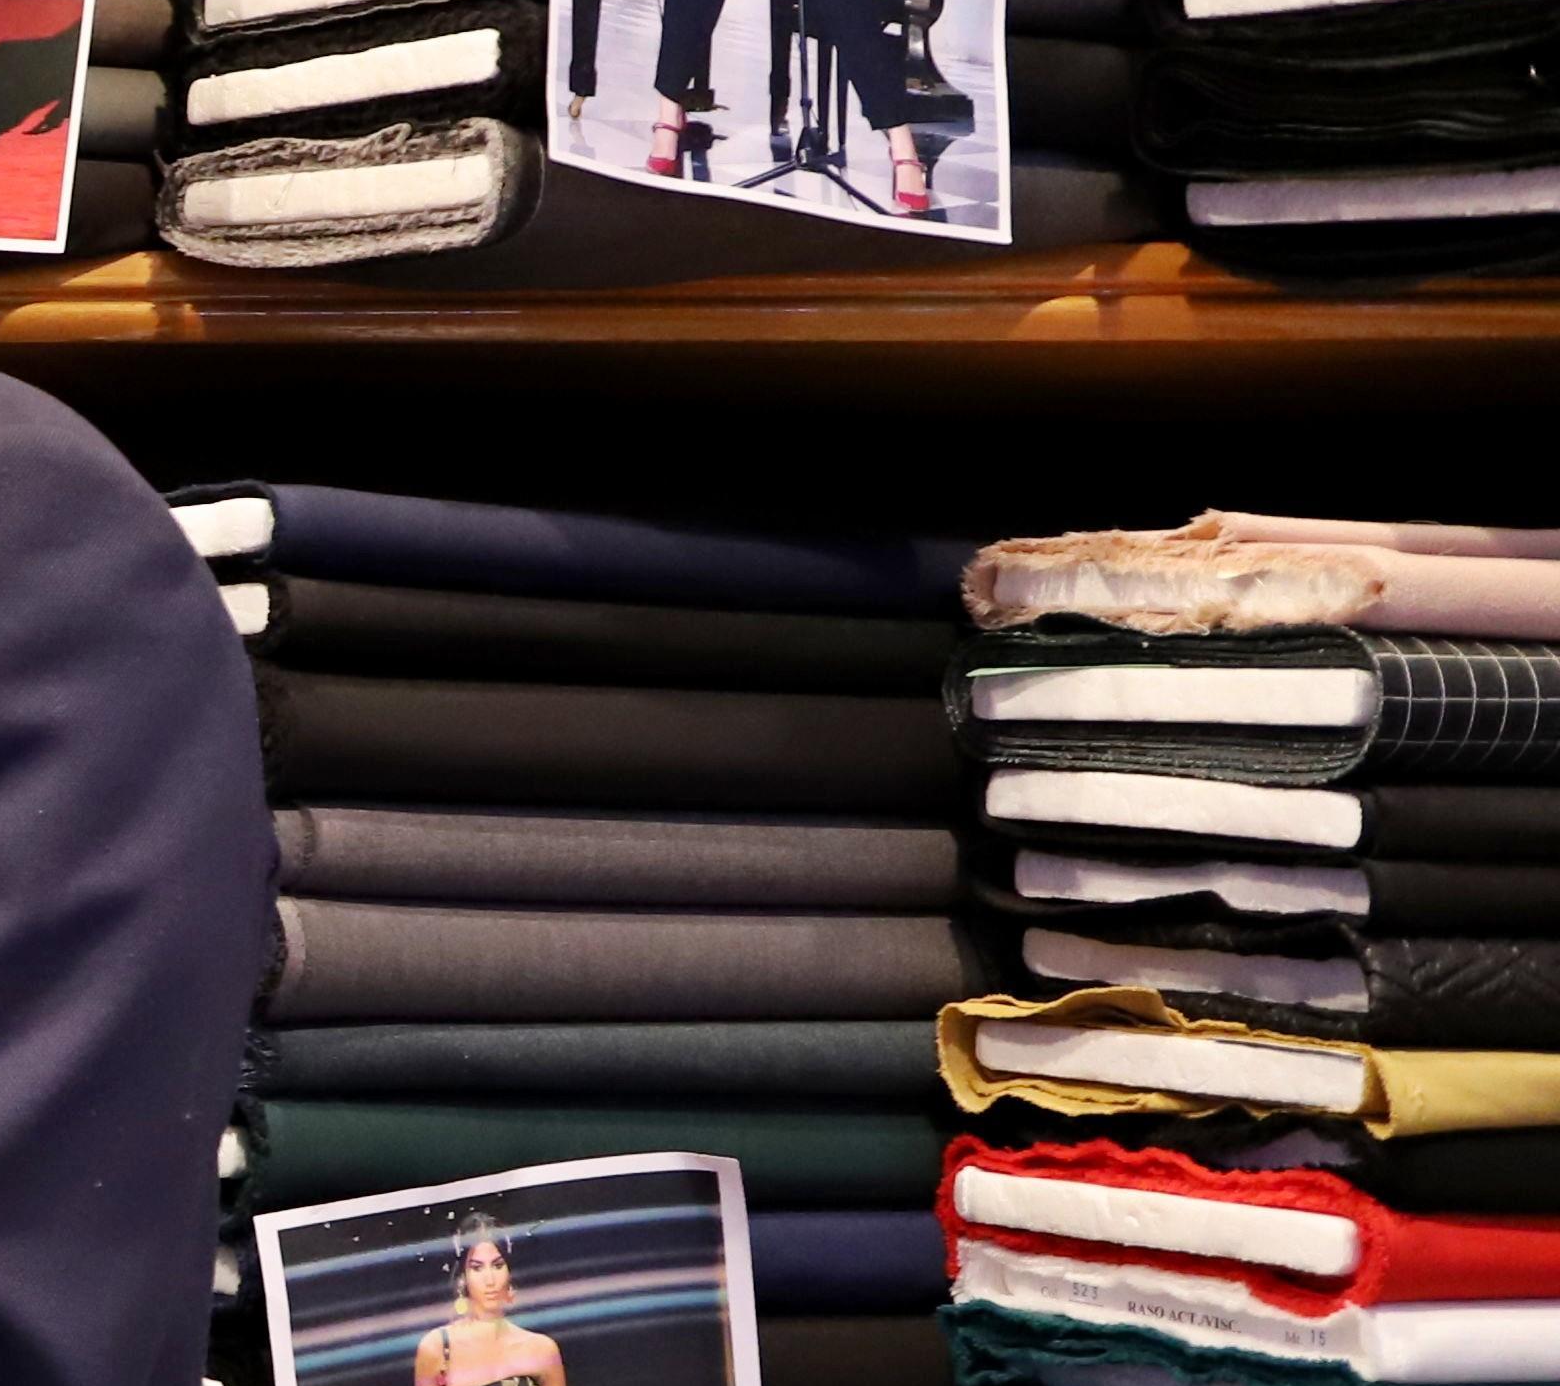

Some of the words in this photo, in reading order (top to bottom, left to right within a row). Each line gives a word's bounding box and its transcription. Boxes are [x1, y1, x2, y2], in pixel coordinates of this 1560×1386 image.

[1072, 1281, 1099, 1300] 523
[1127, 1299, 1165, 1319] RASO
[1310, 1329, 1327, 1346] 15
